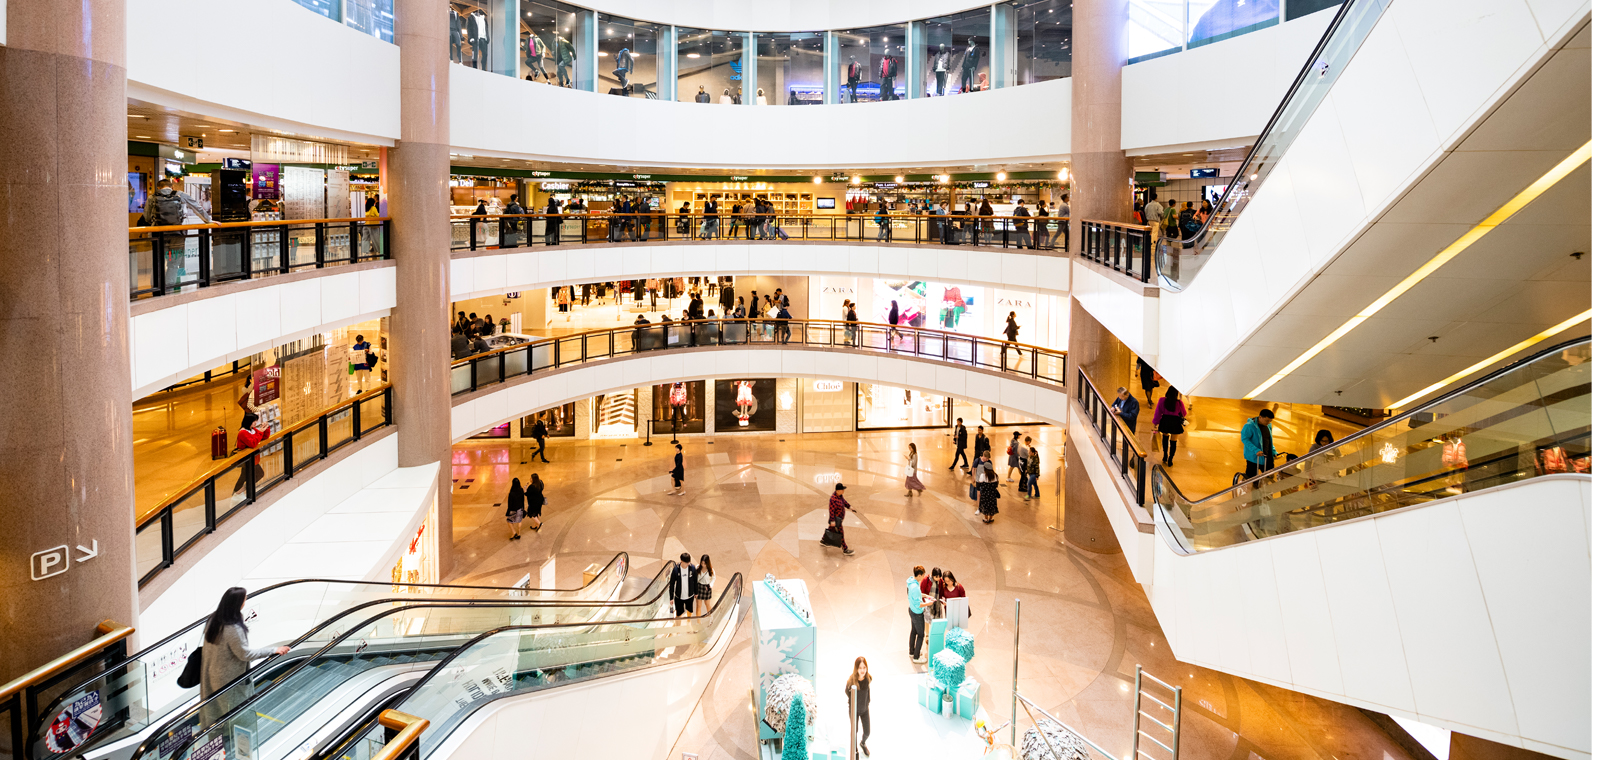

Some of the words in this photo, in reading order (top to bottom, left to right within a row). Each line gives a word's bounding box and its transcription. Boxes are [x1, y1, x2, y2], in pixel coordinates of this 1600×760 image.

[460, 179, 474, 187] Deli
[541, 181, 570, 190] Cashier
[997, 298, 1032, 308] ZARA
[40, 552, 61, 575] P
